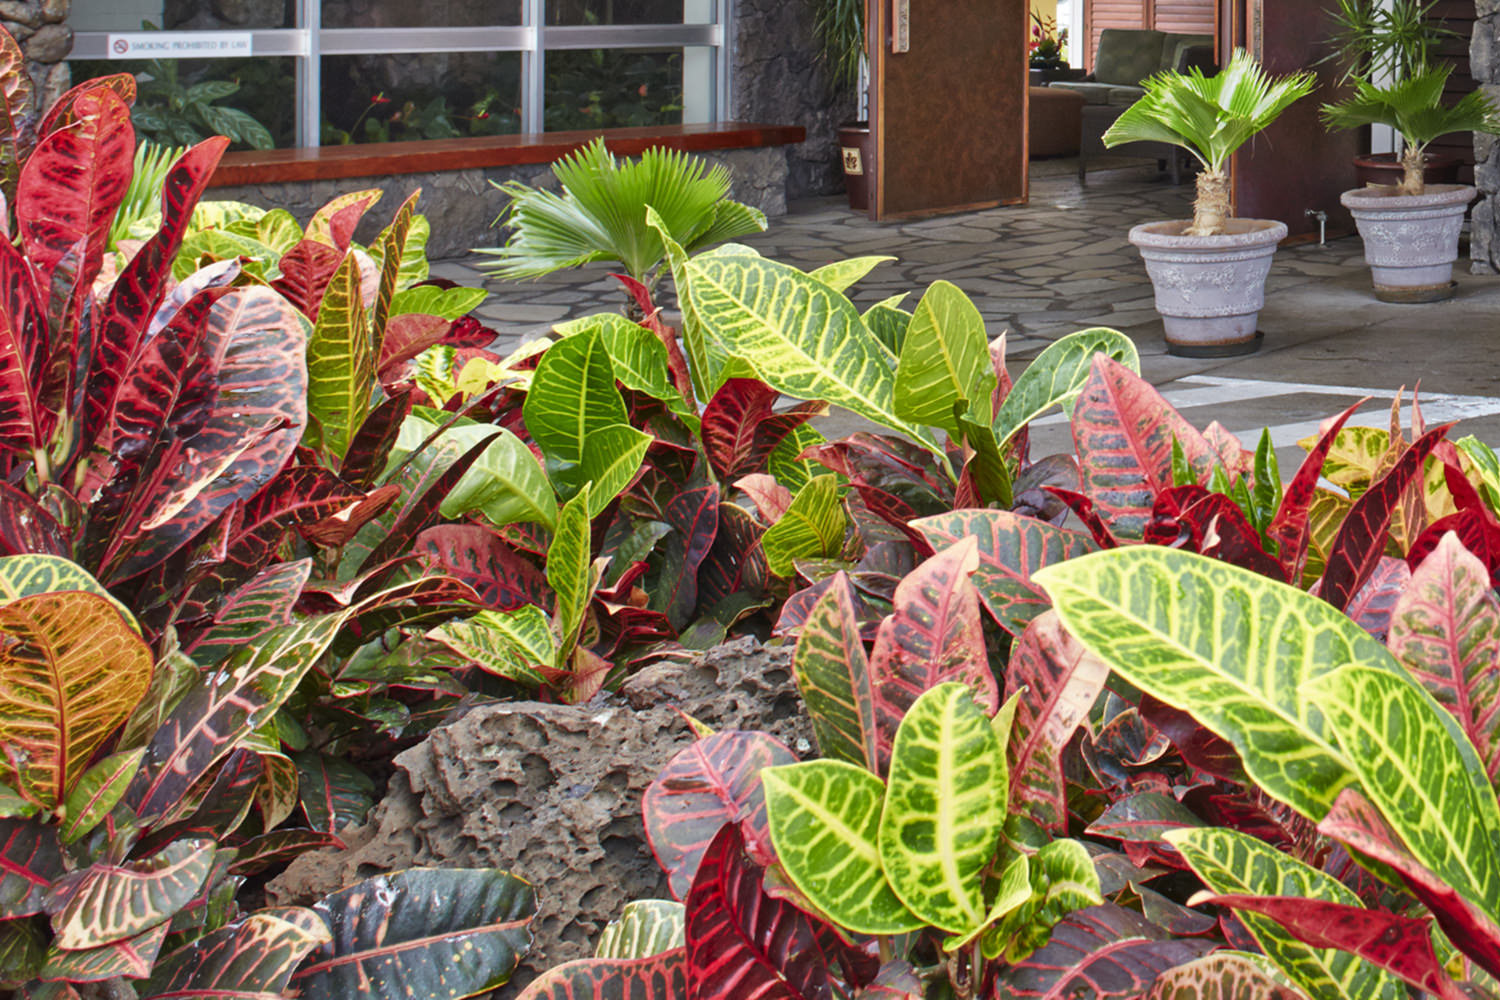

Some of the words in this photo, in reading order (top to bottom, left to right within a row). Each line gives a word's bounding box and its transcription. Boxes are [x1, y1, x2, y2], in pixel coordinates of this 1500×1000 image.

[131, 41, 170, 50] SMOKING
[172, 41, 217, 50] PROHIBITED
[219, 41, 229, 49] BY
[231, 40, 249, 49] LAW
